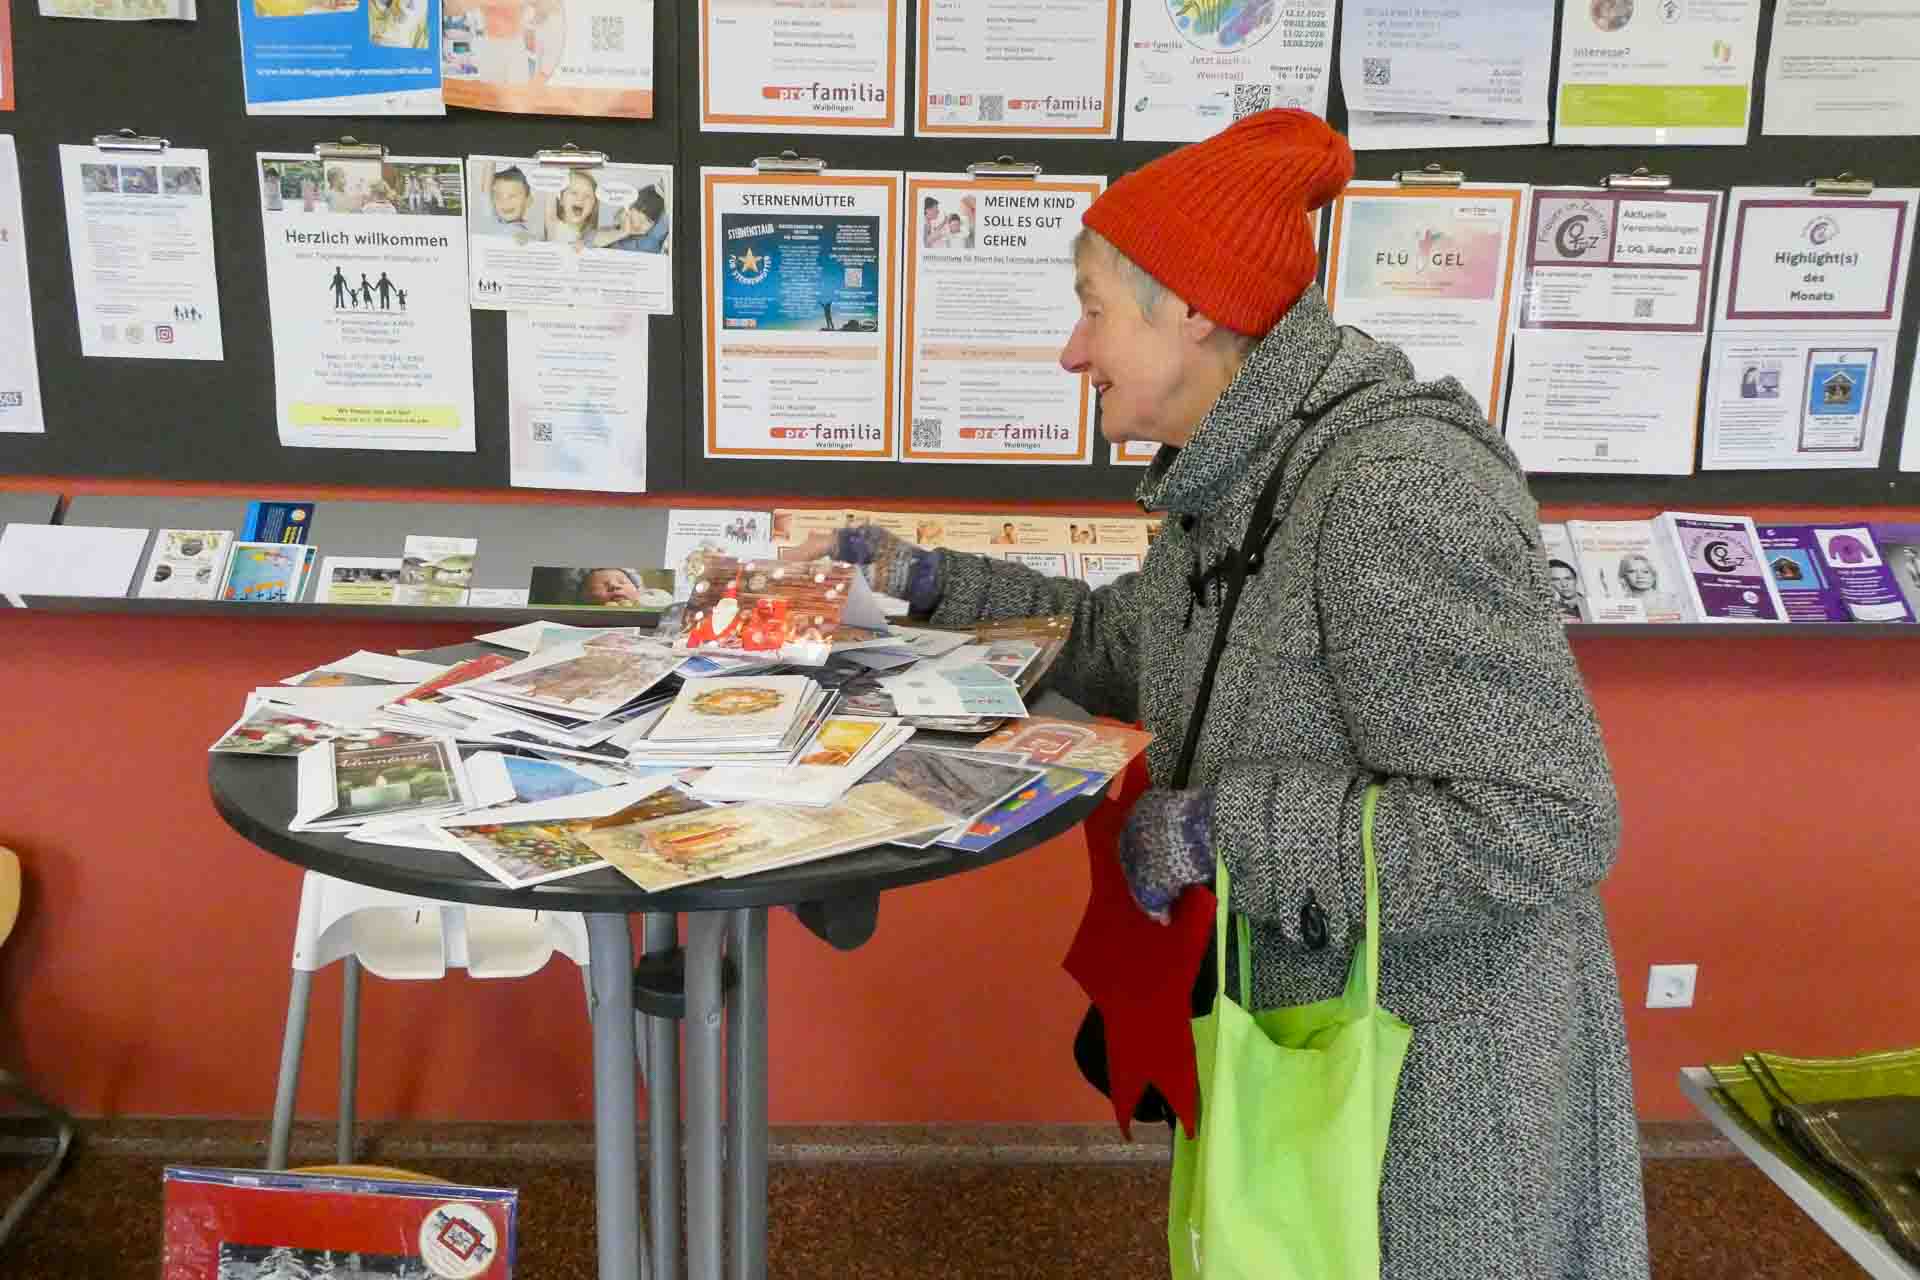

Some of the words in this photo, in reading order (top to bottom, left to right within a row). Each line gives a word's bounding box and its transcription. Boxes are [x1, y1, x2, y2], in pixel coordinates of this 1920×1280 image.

[811, 82, 886, 102] familia
[1046, 95, 1103, 111] familia
[742, 193, 856, 207] STERNENMÜTTER
[984, 195, 1040, 209] MEINEM
[1043, 197, 1076, 210] KIND
[983, 215, 1014, 227] SOLL
[1017, 215, 1032, 228] ES
[1035, 216, 1063, 229] GUT
[285, 229, 349, 245] Herzlich
[354, 232, 449, 248] willkommen
[983, 234, 1027, 247] GEHEN
[1431, 252, 1465, 266] GEL
[1774, 251, 1858, 266] Highlight(s)
[1803, 272, 1825, 284] des
[1790, 290, 1835, 302] Monats
[814, 423, 881, 440] familia
[1002, 423, 1070, 440] familia
